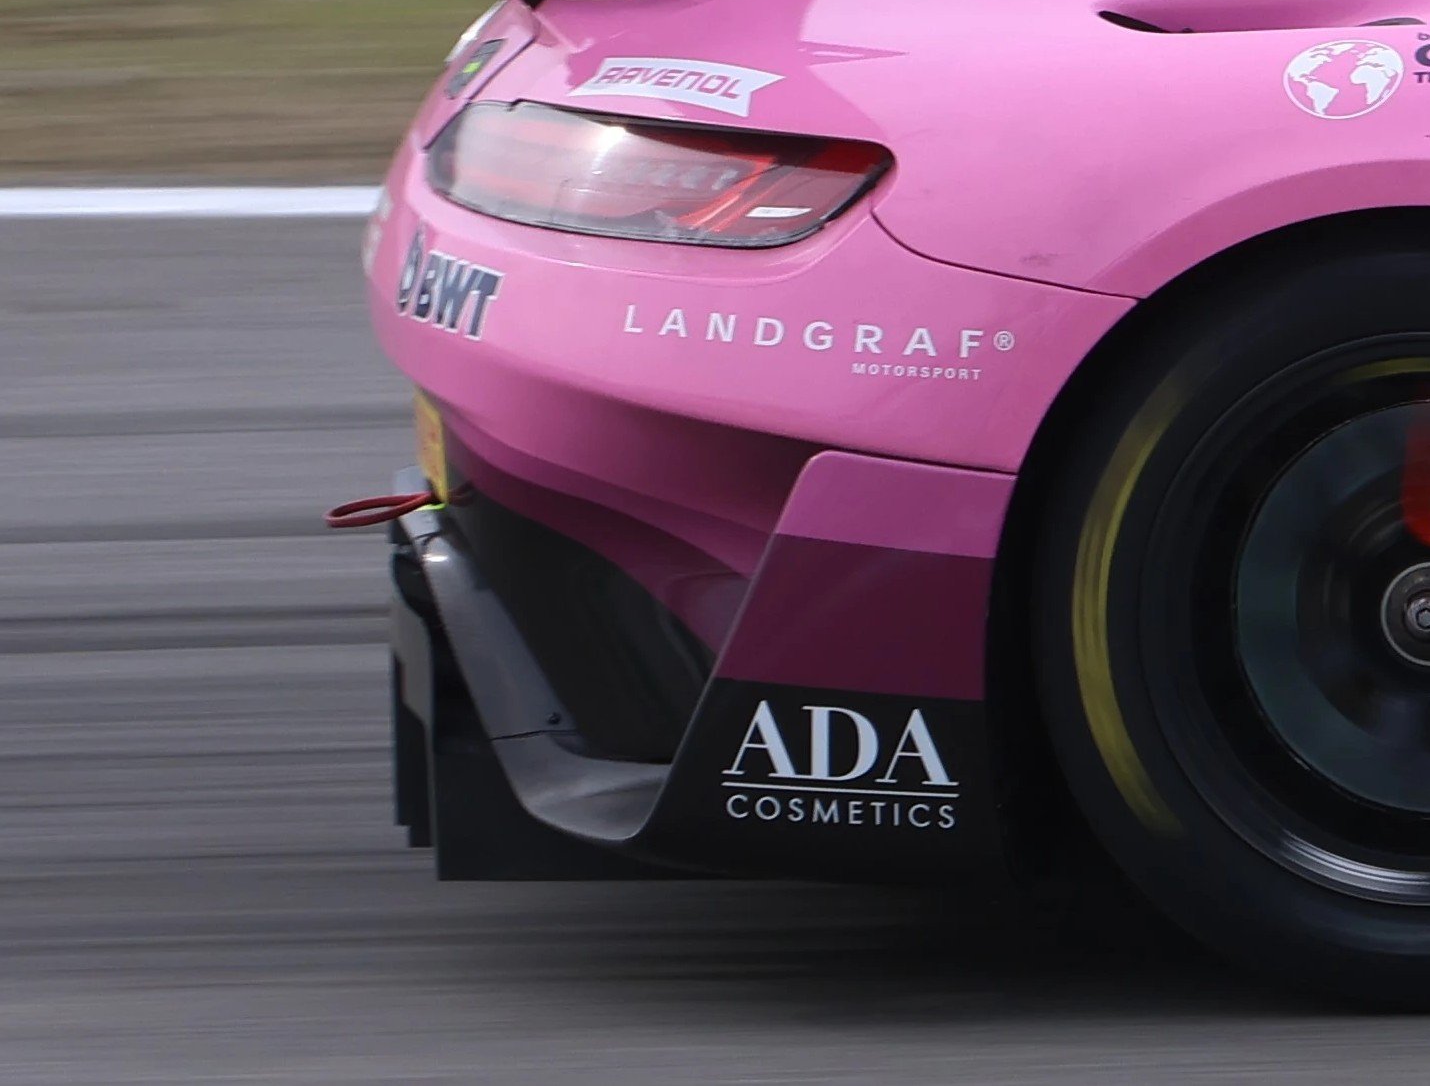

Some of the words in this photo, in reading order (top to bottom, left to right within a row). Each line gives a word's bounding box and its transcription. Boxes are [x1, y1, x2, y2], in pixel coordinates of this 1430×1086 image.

[593, 66, 742, 99] RAVENOL
[410, 249, 506, 341] BWT
[852, 363, 981, 380] MOTORSPORT
[723, 699, 958, 787] ADA
[726, 794, 956, 829] COSMETICS
